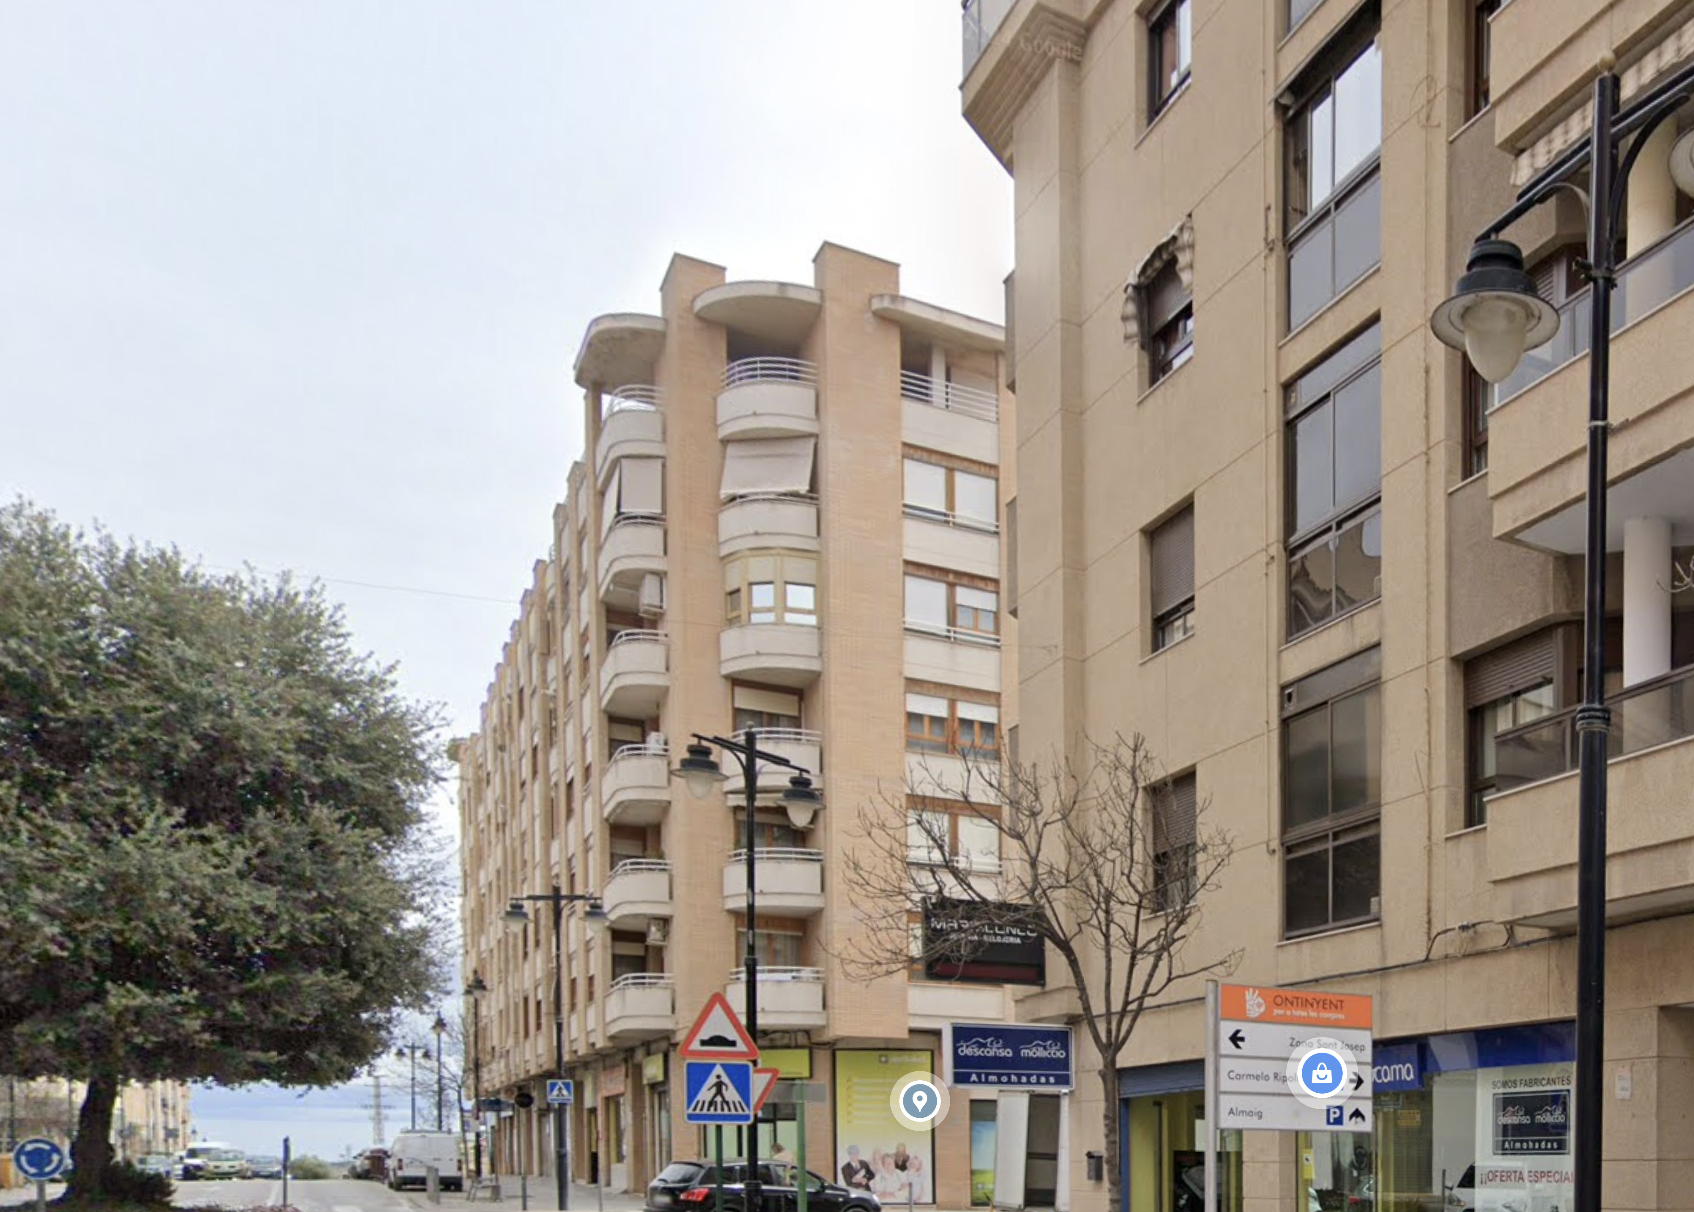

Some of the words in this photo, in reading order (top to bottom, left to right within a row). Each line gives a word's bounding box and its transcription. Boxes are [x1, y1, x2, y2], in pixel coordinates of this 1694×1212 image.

[1273, 994, 1345, 1011] ONTINYENT
[1289, 1037, 1314, 1049] Zona
[1316, 1039, 1338, 1050] Sant
[1340, 1040, 1366, 1053] Josep
[969, 1073, 1056, 1084] Almohadas
[1227, 1069, 1271, 1082] Carmelo
[1373, 1062, 1415, 1084] cama
[1492, 1078, 1518, 1090] SOMOS
[1519, 1075, 1572, 1089] FABRICANTES
[1227, 1107, 1263, 1119] Almaig
[1503, 1140, 1558, 1150] Almohadas
